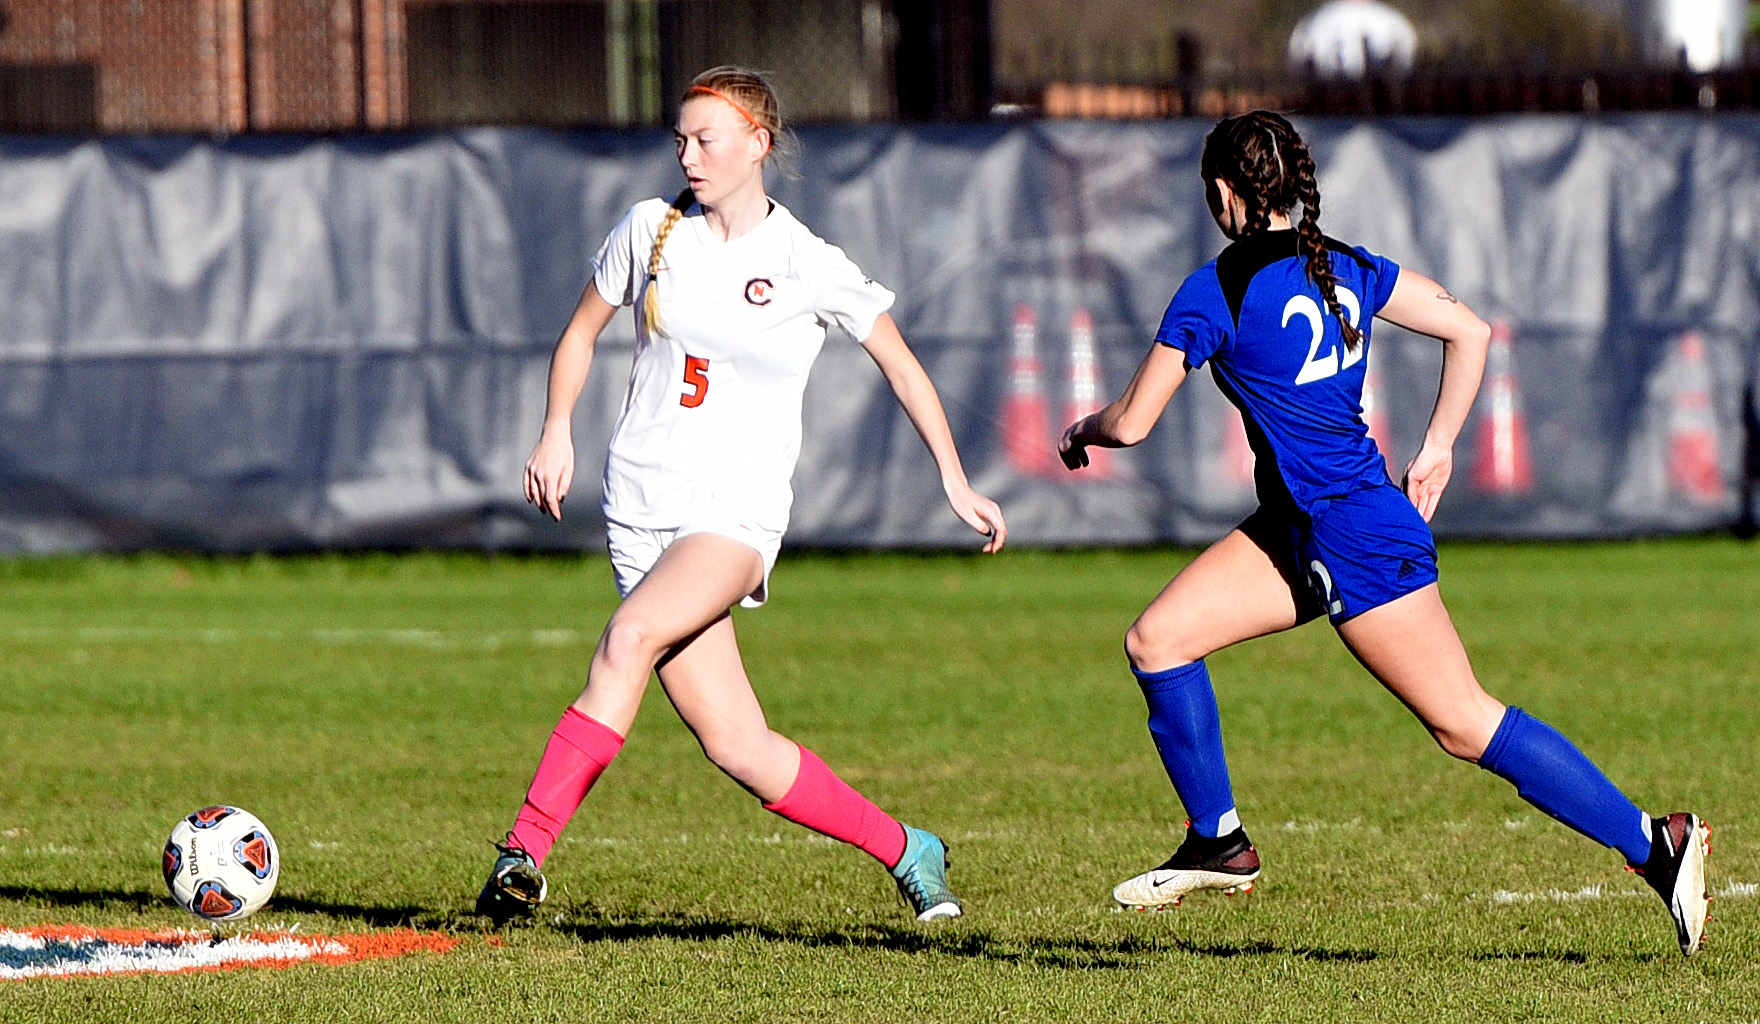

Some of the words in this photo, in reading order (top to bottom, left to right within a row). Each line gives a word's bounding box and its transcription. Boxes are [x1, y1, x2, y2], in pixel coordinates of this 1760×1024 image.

[1281, 284, 1364, 386] 22
[679, 353, 710, 409] 5
[188, 836, 199, 876] Wilson
